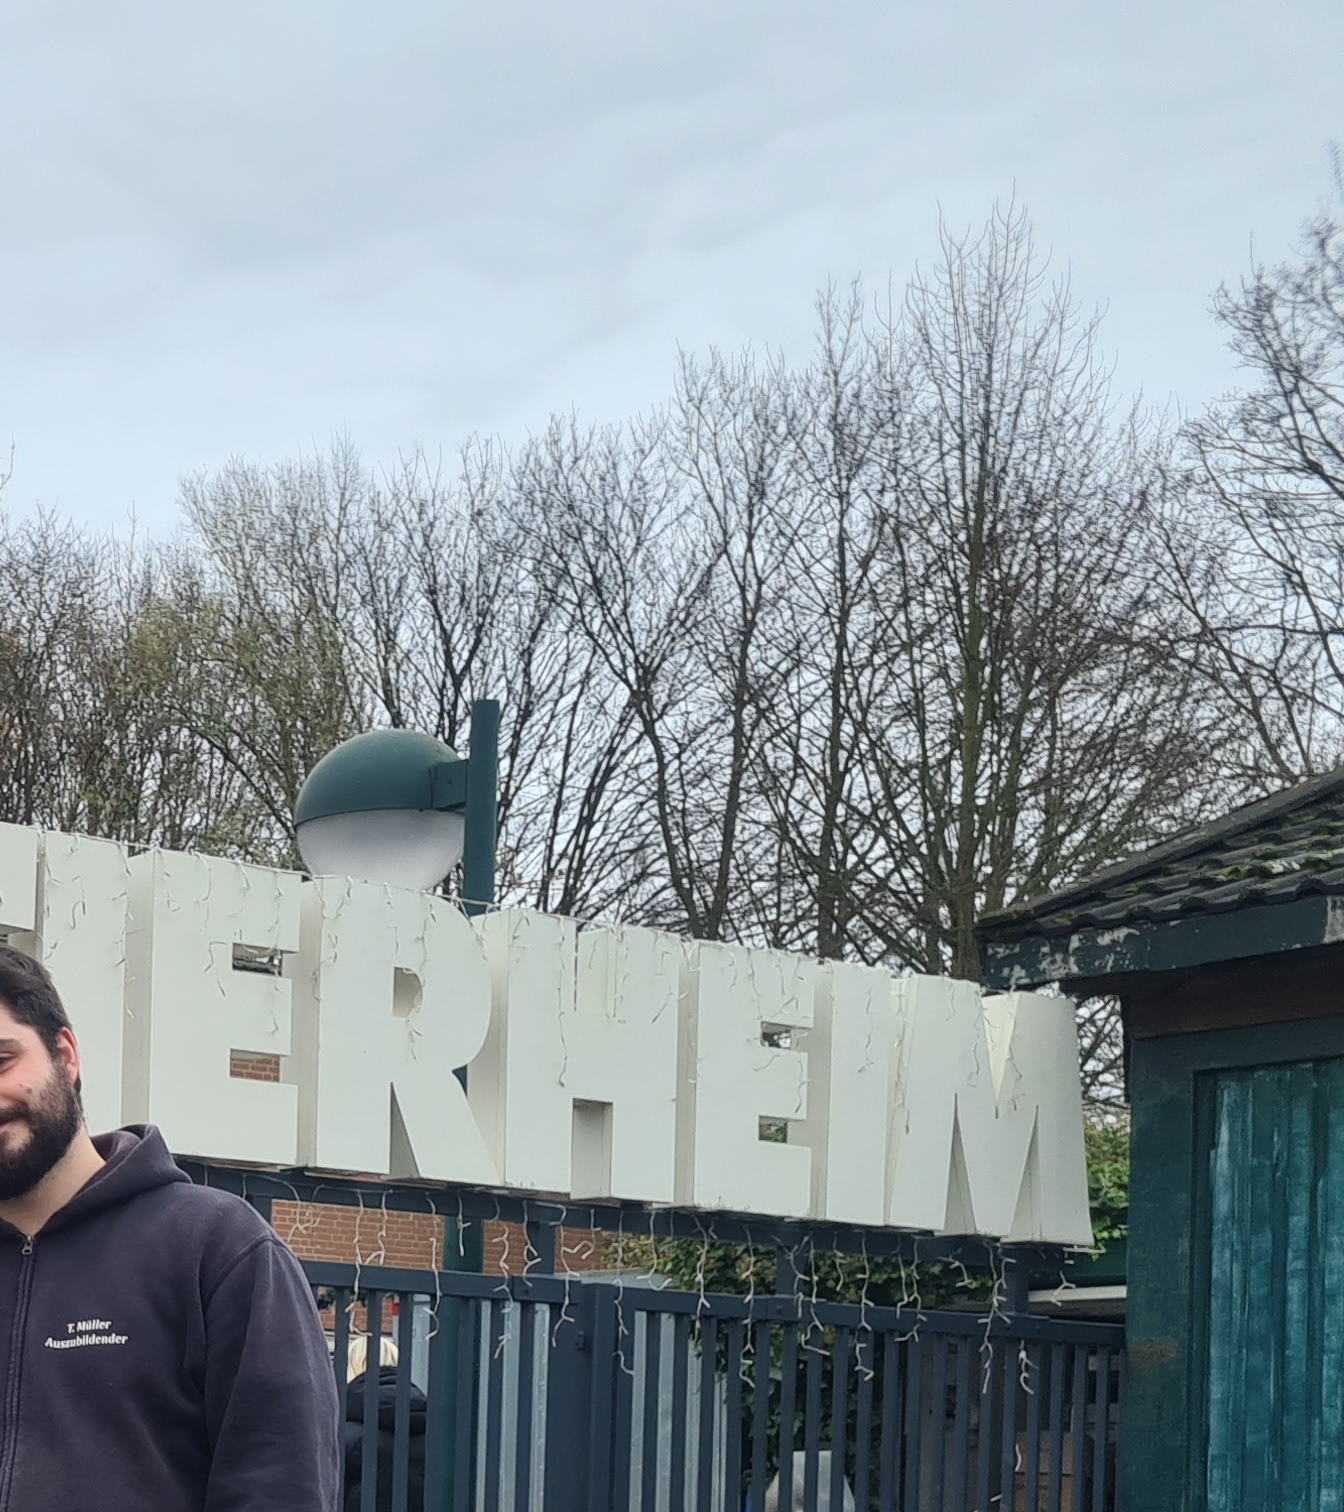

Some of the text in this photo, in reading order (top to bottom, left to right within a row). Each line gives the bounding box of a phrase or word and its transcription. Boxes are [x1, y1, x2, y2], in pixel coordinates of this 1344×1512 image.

[67, 1319, 112, 1334] T. Müller
[44, 1333, 129, 1349] Auszubildender
